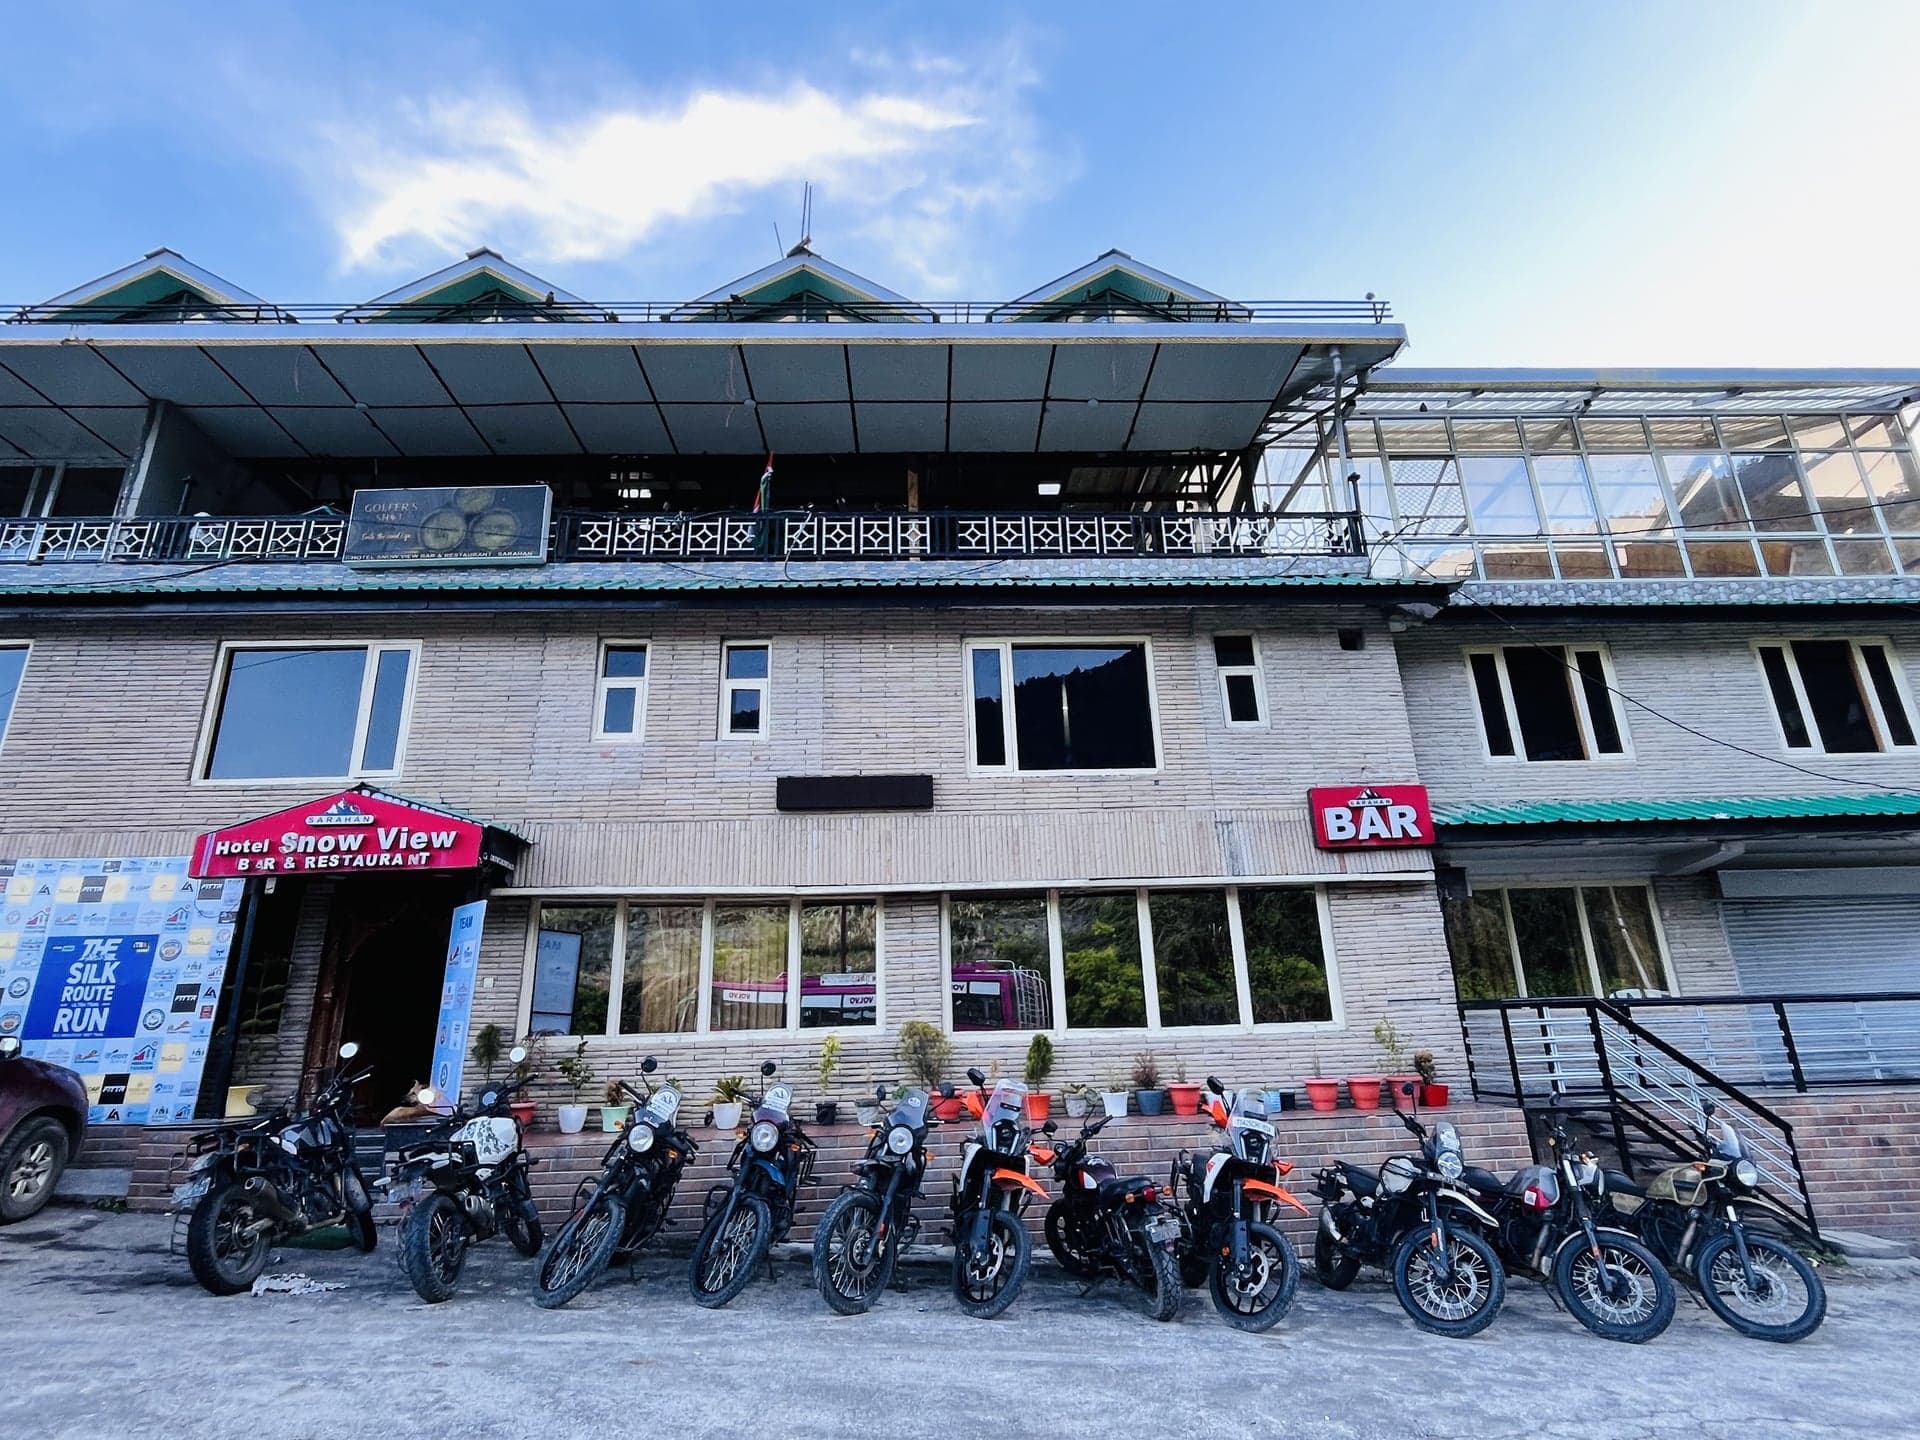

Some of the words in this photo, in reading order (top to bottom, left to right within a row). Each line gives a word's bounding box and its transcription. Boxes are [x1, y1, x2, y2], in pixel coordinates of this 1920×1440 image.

[1323, 804, 1422, 840] BAR
[215, 838, 269, 855] Hotel
[279, 831, 366, 854] Snow
[376, 827, 457, 850] View
[237, 856, 275, 871] BAR
[284, 856, 295, 870] &
[304, 852, 430, 869] RESTAURANT
[459, 916, 473, 930] TEAM
[78, 938, 123, 960] THE
[66, 961, 121, 984] SILK
[61, 985, 115, 1002] ROUTE
[53, 1007, 110, 1033] RUN
